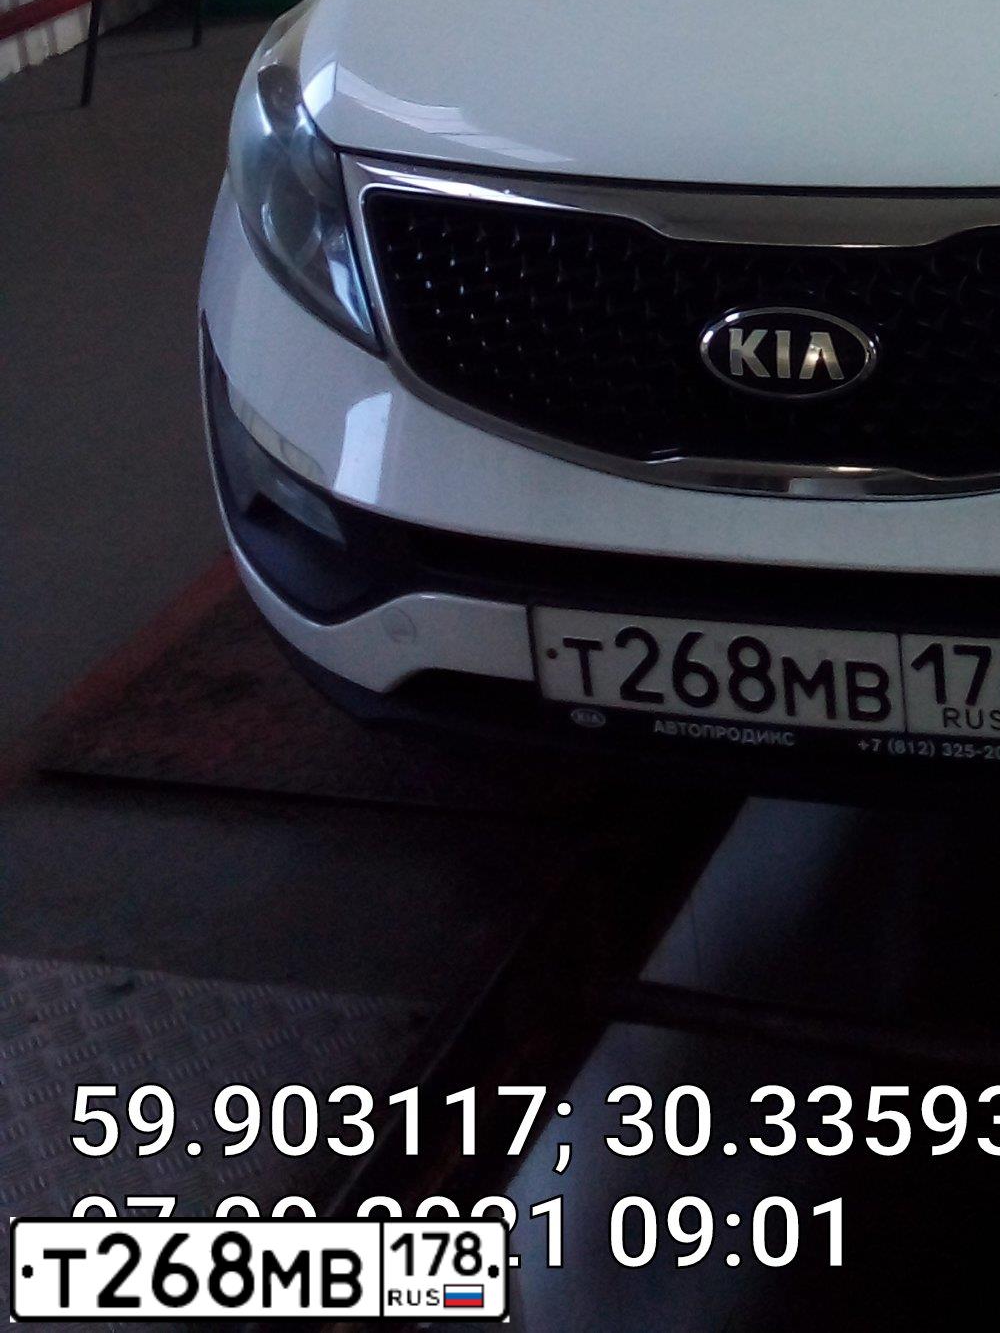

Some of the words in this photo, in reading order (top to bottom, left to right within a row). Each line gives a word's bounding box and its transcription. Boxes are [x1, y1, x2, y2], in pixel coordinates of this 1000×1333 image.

[728, 327, 846, 381] KIA
[856, 738, 882, 753] +7
[886, 738, 936, 758] (812)
